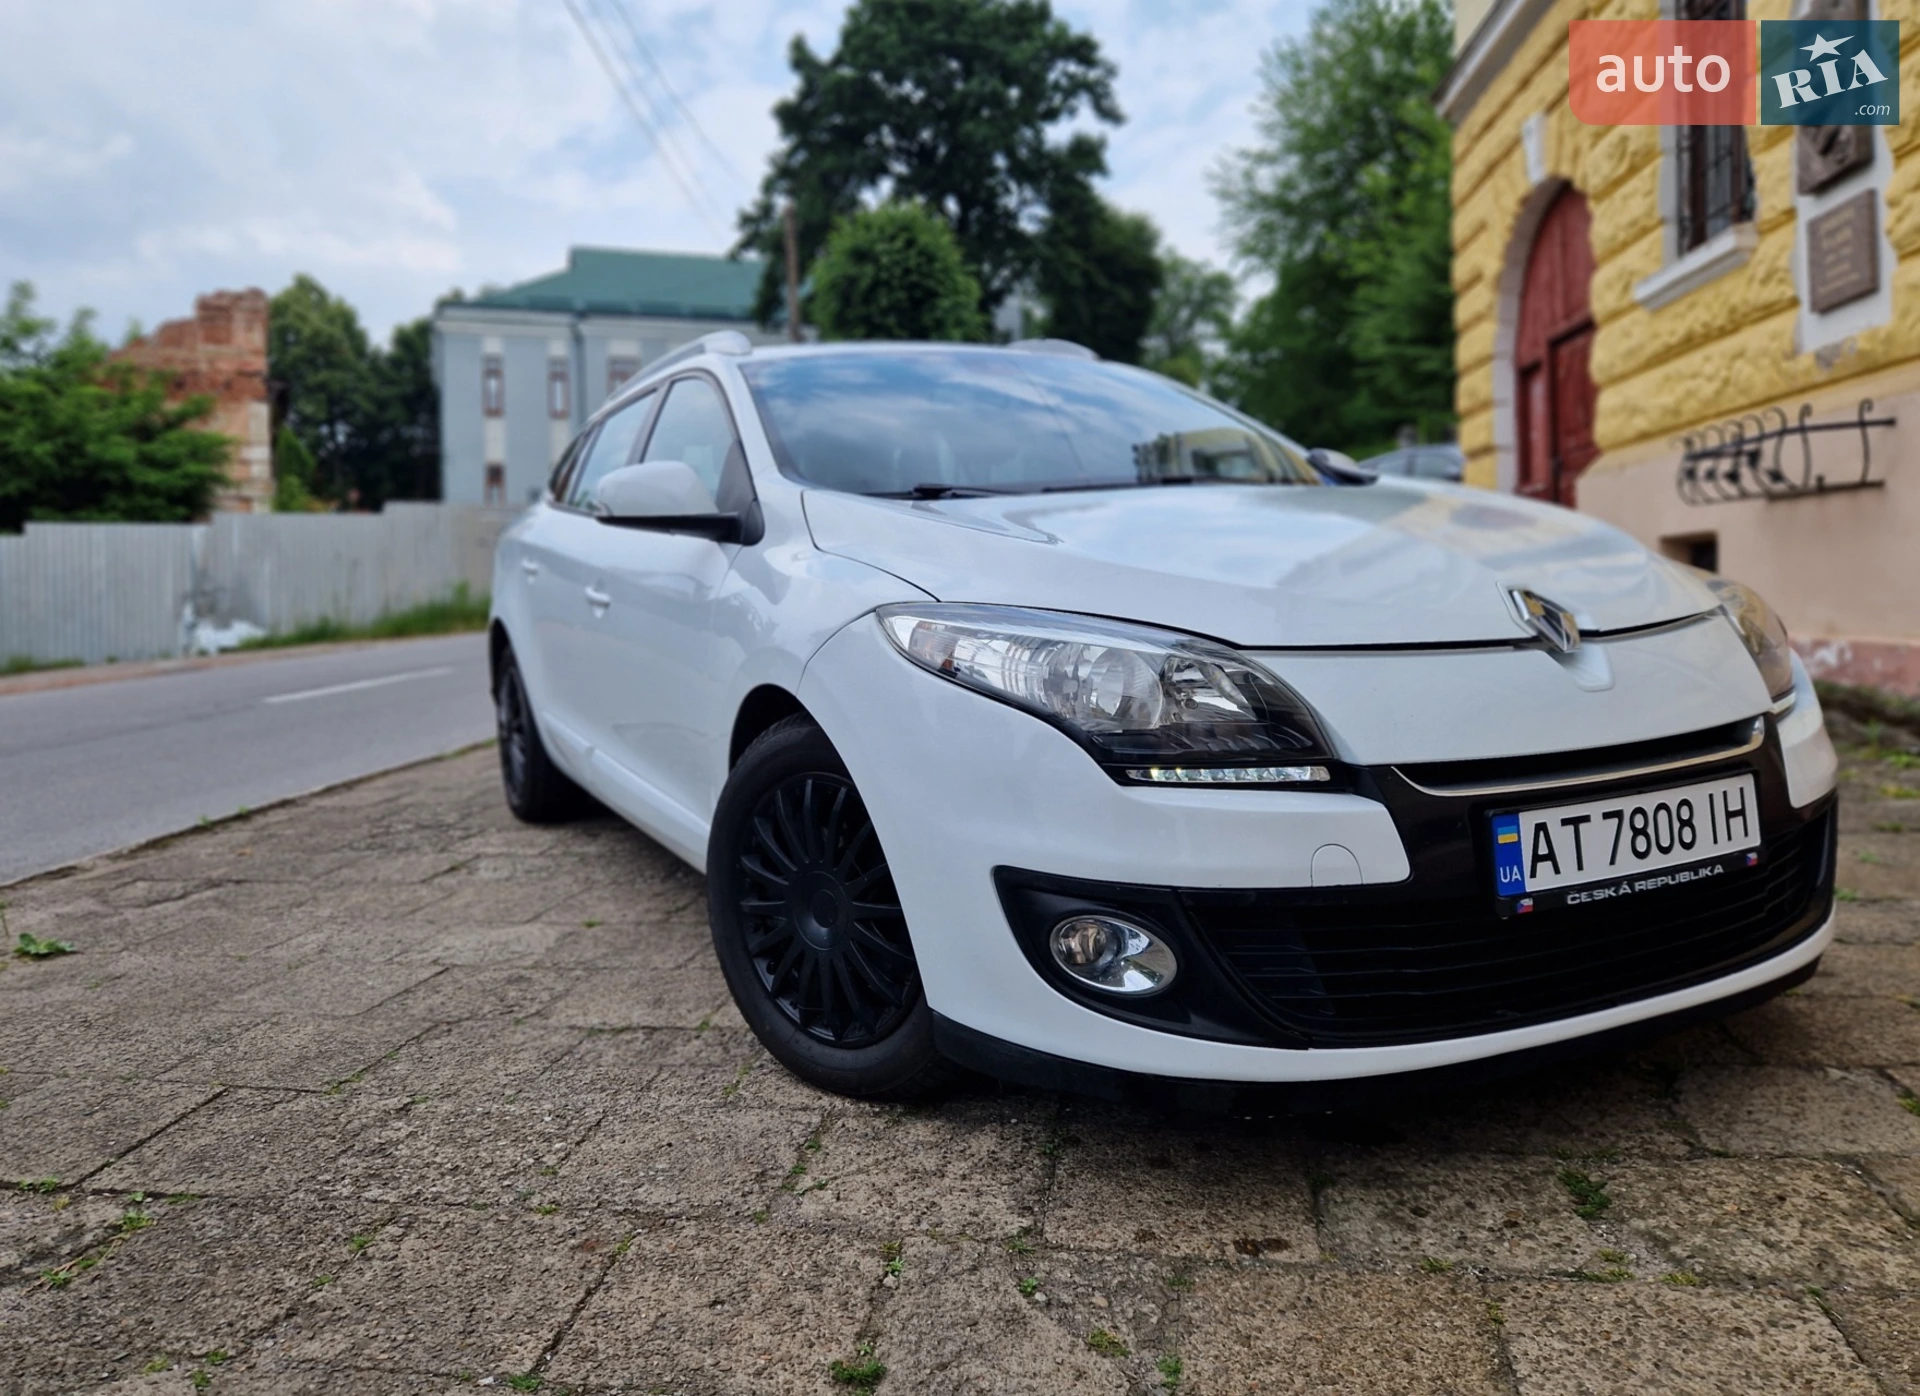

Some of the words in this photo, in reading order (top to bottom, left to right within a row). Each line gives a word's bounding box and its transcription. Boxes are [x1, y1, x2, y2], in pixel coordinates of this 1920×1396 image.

[1529, 814, 1591, 879] AT
[1602, 798, 1697, 866] 7808
[1708, 787, 1749, 845] IH
[1499, 865, 1522, 884] UA
[1566, 882, 1632, 905] ČESKÁ
[1634, 864, 1724, 893] REPUBLIKA
